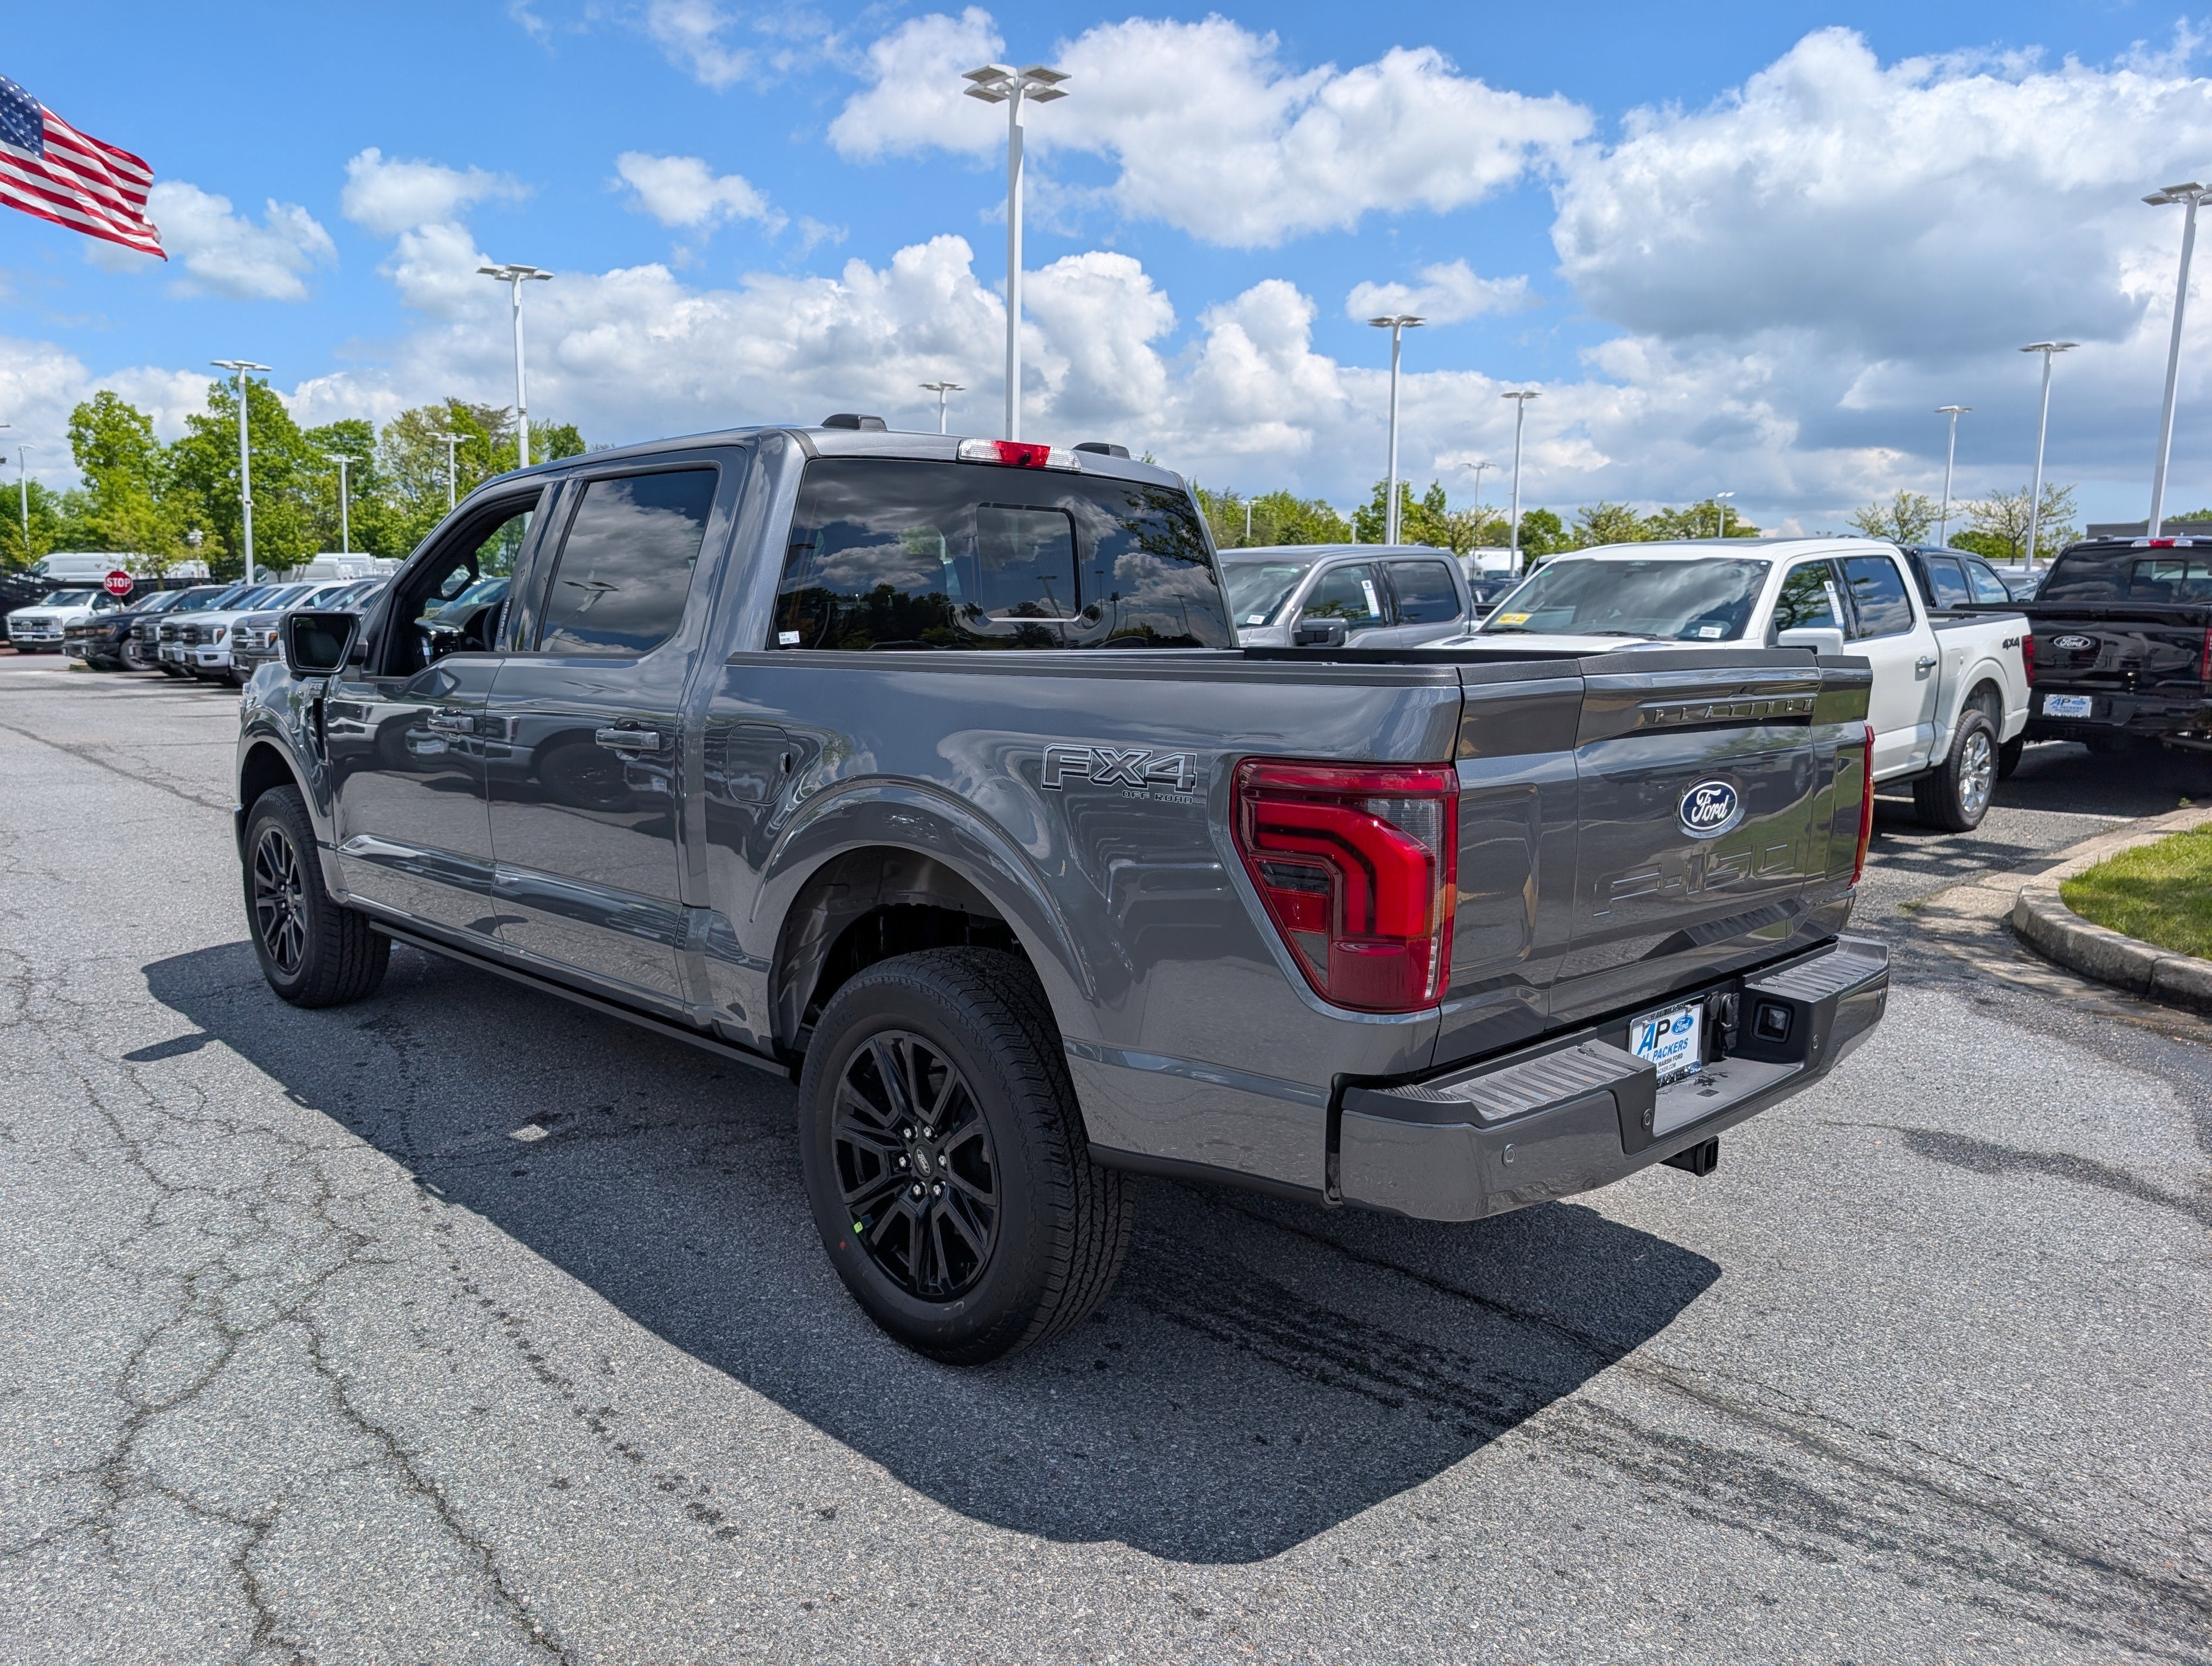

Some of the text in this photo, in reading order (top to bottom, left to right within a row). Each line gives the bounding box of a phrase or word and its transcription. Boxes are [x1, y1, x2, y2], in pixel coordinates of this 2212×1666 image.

[107, 577, 131, 588] STOP
[1041, 743, 1197, 794] FX4
[1122, 790, 1193, 804] OFF ROAD
[1636, 1018, 1671, 1056] AP
[1652, 1037, 1689, 1062] PACKERS
[1658, 1052, 1683, 1068] MARSH FORD
